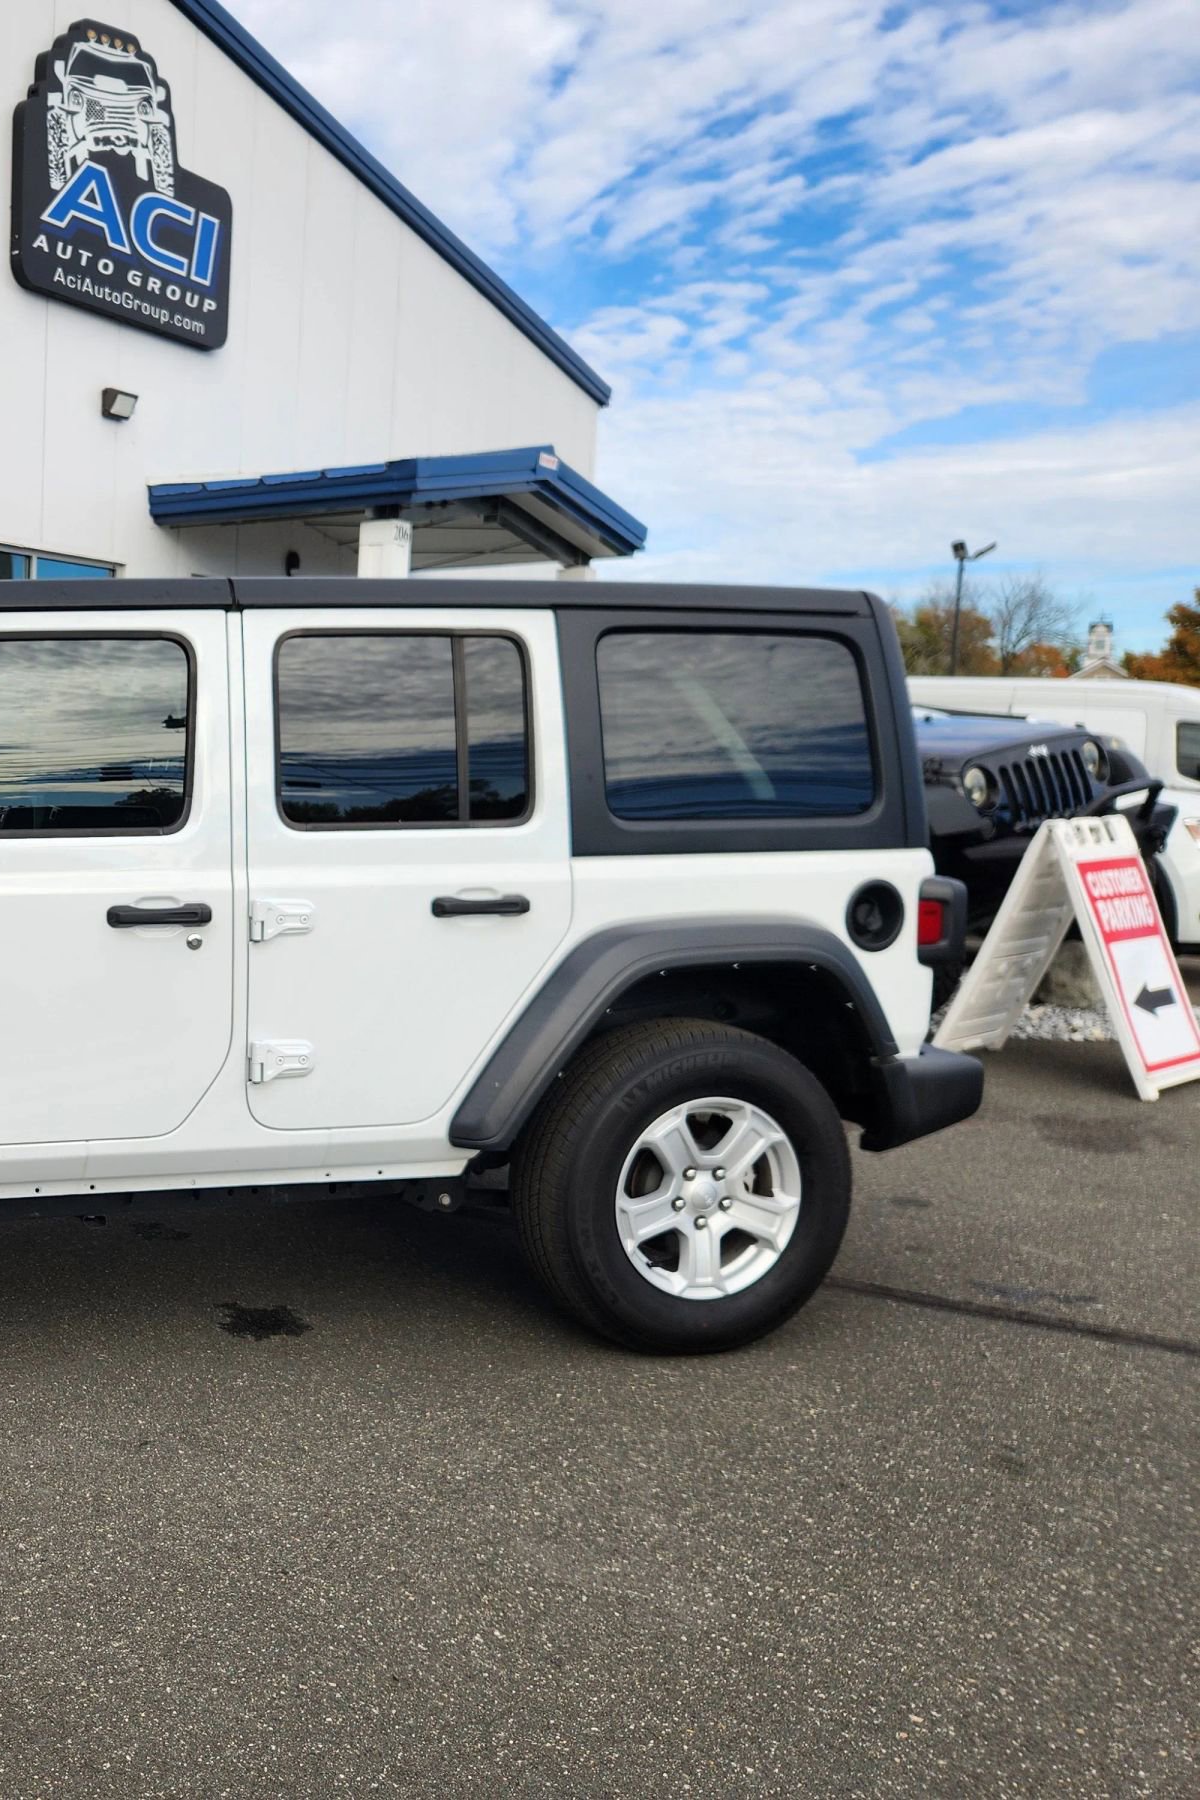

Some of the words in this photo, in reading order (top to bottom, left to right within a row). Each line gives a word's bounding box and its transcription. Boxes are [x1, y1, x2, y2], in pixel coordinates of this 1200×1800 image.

[40, 158, 220, 287] ACI
[32, 235, 114, 275] AUTO
[127, 269, 217, 313] GROUP
[52, 267, 206, 335] AciAutoGroup.com
[1085, 866, 1145, 898] CUSTOMER
[1095, 893, 1155, 933] PARKING
